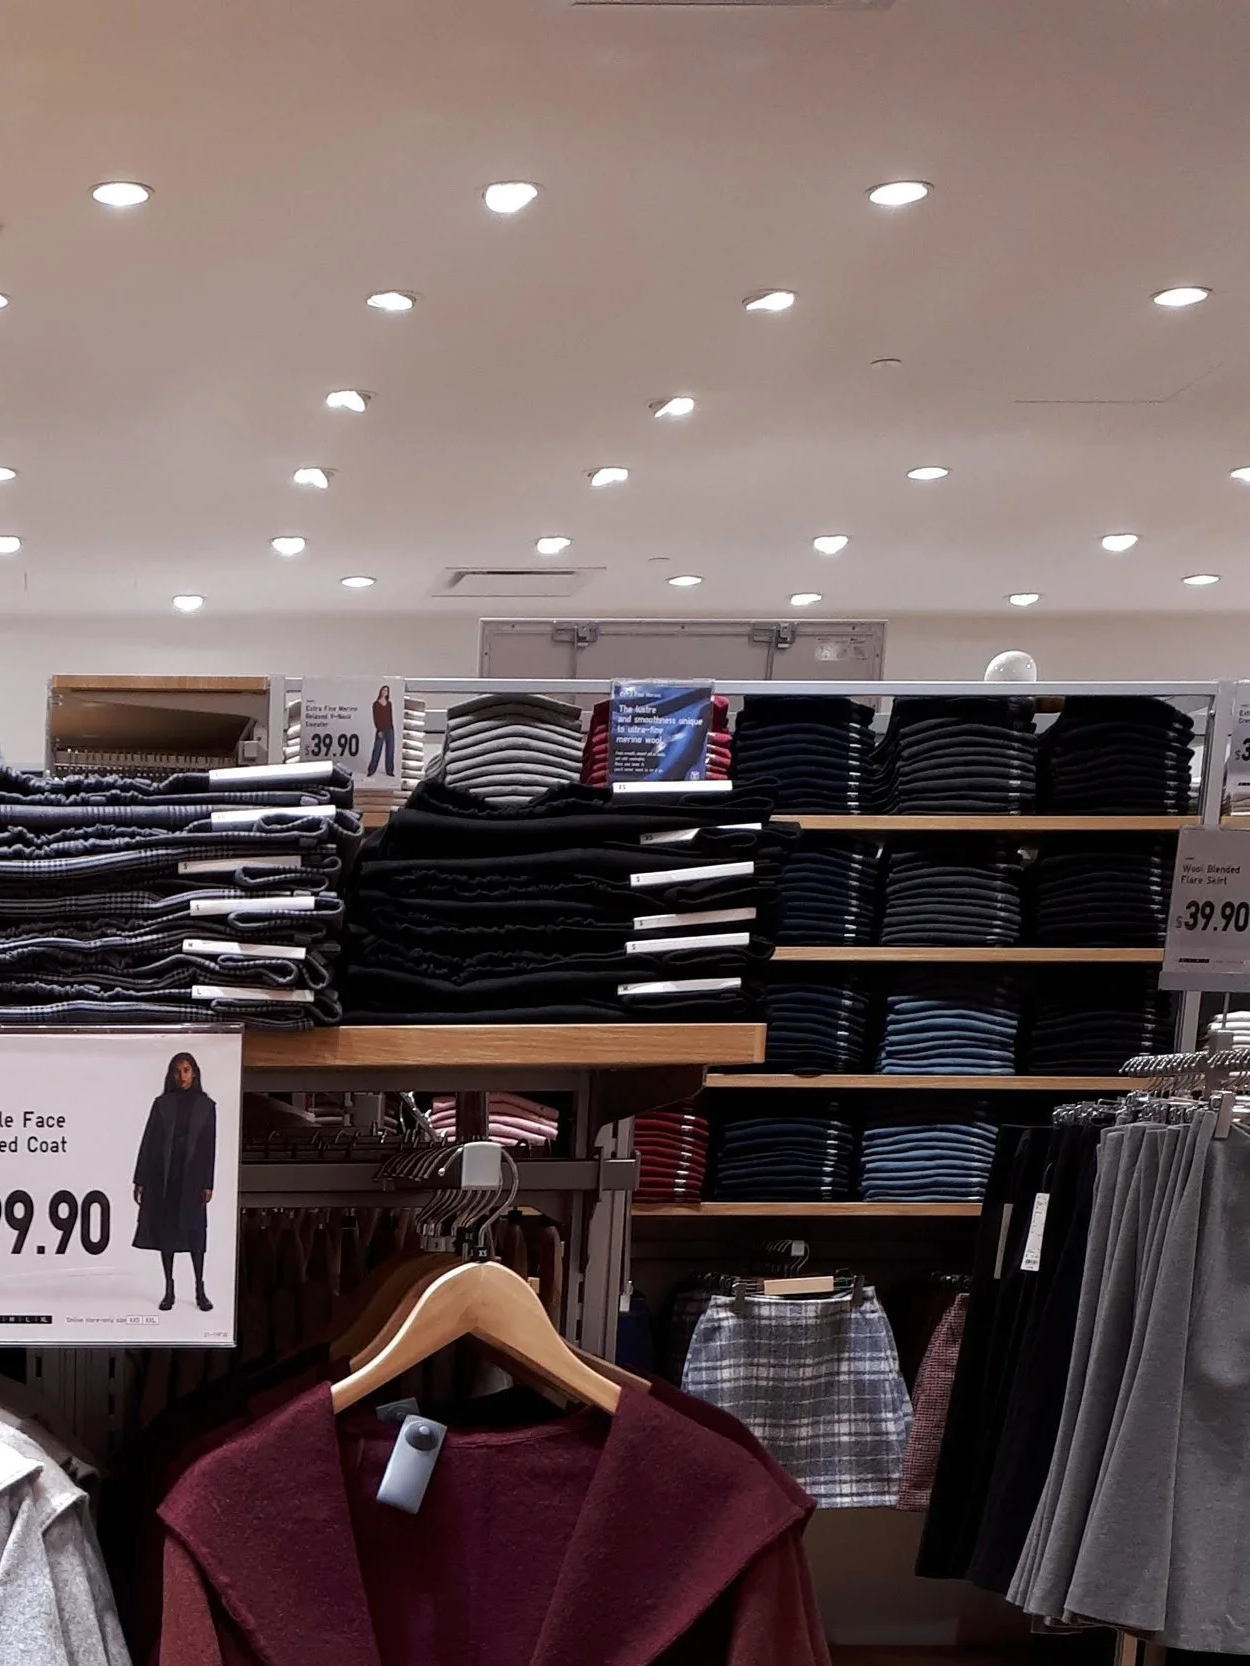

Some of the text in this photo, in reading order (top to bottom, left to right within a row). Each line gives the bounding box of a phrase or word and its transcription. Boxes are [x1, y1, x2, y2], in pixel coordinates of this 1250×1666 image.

[619, 704, 657, 714] The lustre
[617, 715, 703, 728] and smoothness unique
[627, 726, 664, 734] ultra-fine
[305, 733, 360, 757] $39.90
[1182, 864, 1241, 875] Wool Blended
[1181, 875, 1228, 886] Flare Skirt
[1175, 900, 1250, 932] $39.90
[23, 1111, 66, 1128] Face
[27, 1136, 67, 1153] Coat
[478, 1249, 488, 1257] XS
